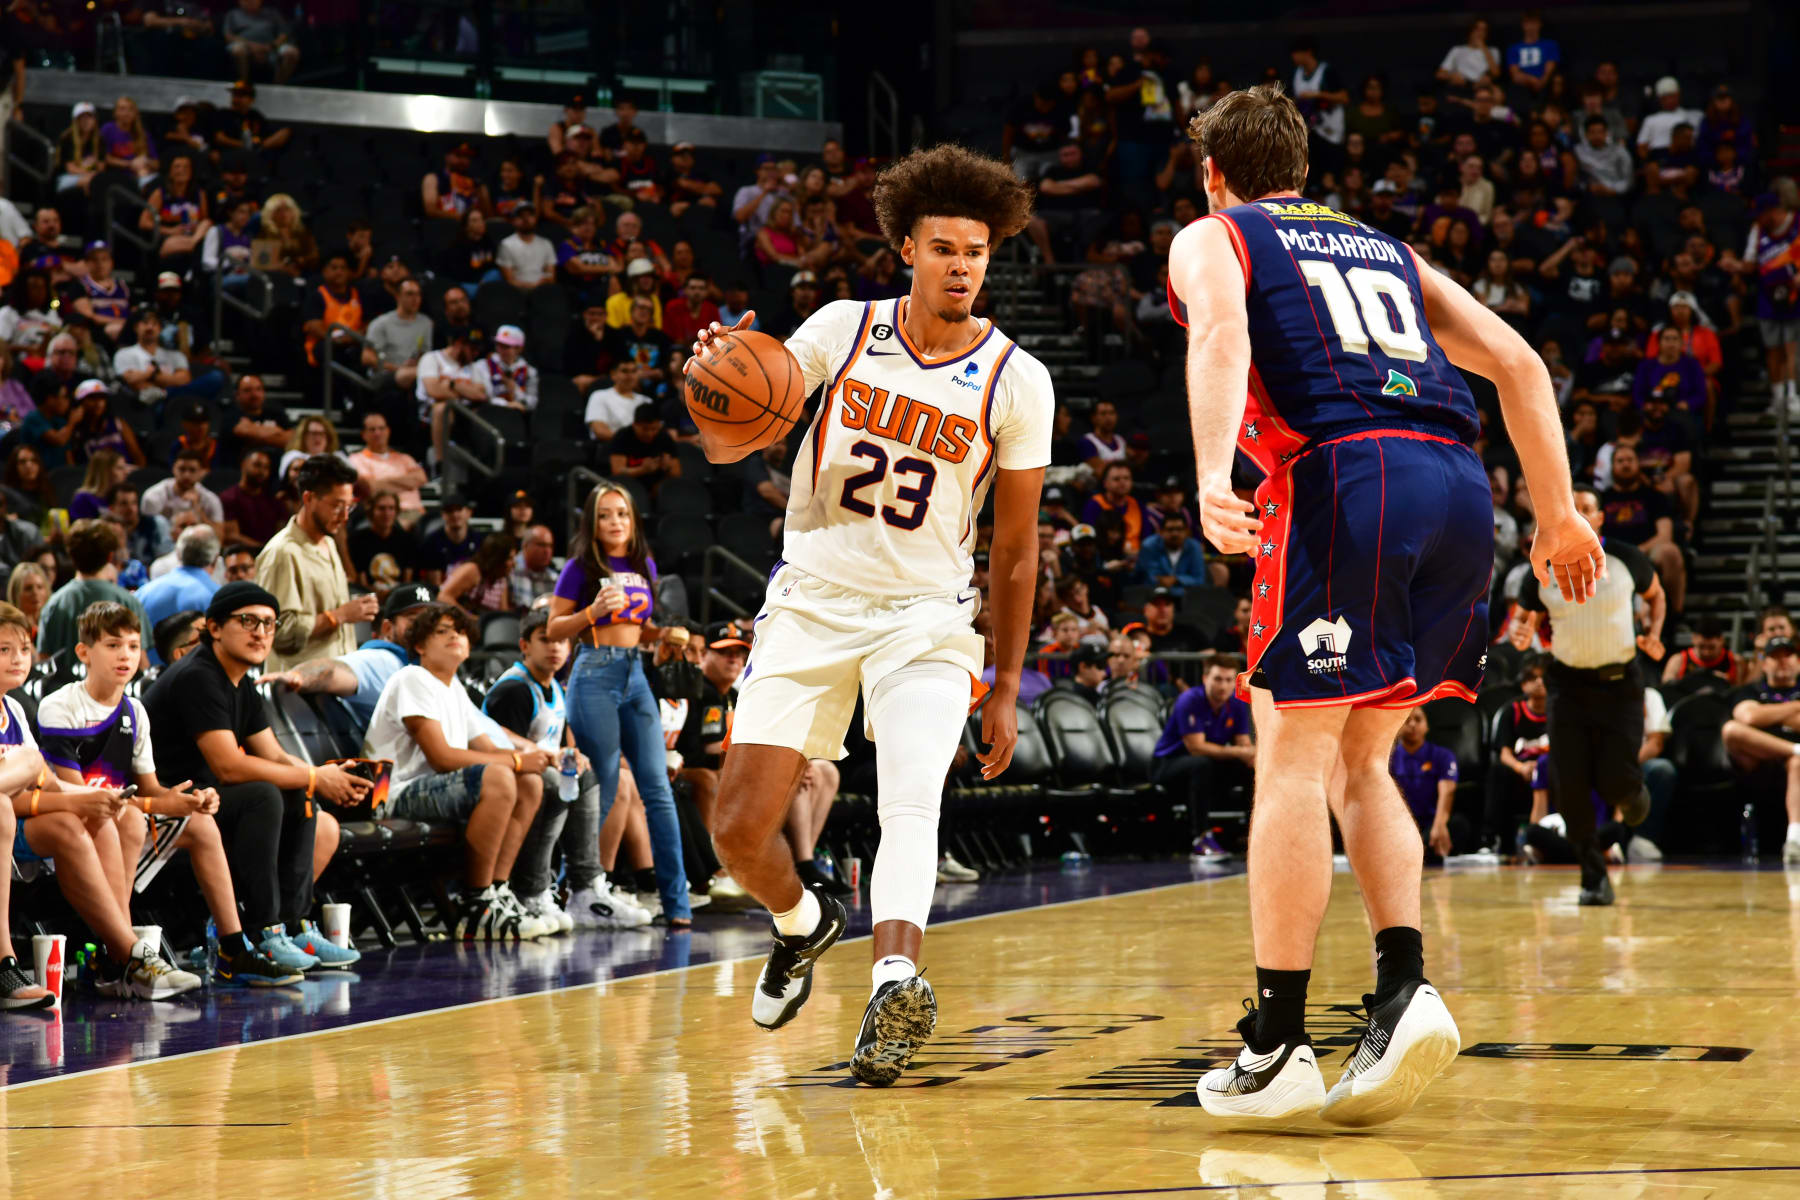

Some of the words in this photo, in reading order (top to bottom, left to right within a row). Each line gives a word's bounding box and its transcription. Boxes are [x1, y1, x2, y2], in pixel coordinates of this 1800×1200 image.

[1275, 229, 1404, 265] McCARRON
[1298, 260, 1428, 363] 10
[876, 326, 888, 339] 6
[952, 375, 981, 391] PayPal
[841, 378, 978, 464] SUNS
[840, 440, 937, 531] 23
[1307, 655, 1347, 669] SOUTH
